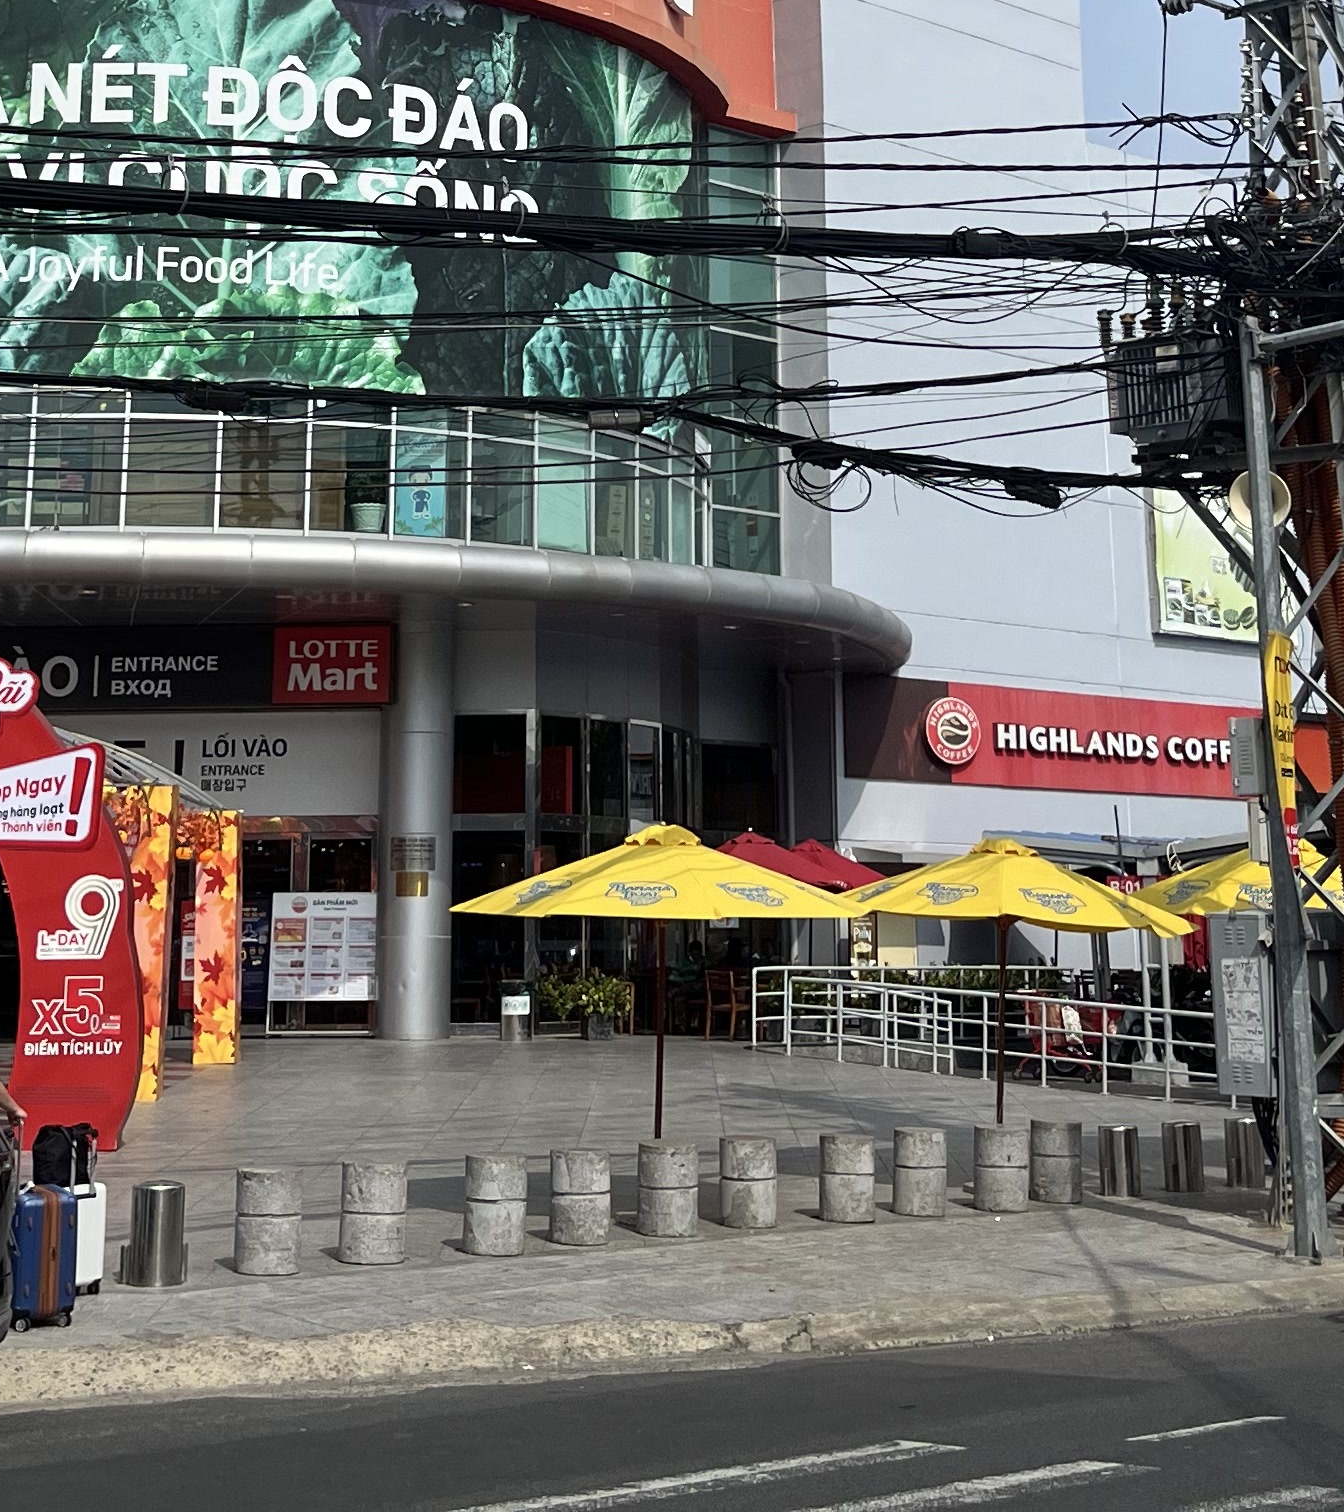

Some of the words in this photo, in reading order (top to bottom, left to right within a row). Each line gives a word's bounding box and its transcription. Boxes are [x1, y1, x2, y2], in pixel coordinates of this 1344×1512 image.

[28, 44, 189, 124] NÉT
[387, 78, 531, 164] ĐÁO
[18, 245, 145, 292] Joyful
[156, 245, 254, 285] Food
[264, 246, 340, 291] Life
[289, 639, 379, 659] LOTTE
[110, 654, 220, 673] ENTRANCE
[286, 661, 379, 692] Mart
[110, 678, 173, 699] ВХОД
[927, 700, 979, 730] HIGHLANDS
[201, 731, 237, 759] LỐI
[242, 732, 289, 758] VÀO
[935, 742, 976, 763] COFFEE
[995, 723, 1160, 760] HIGHLANDS
[1167, 736, 1232, 764] COFF
[201, 763, 266, 777] ENTRANCE
[15, 774, 67, 799] Ngay
[39, 802, 65, 819] loạt
[36, 819, 63, 832] viên
[40, 932, 90, 946] L-DAY
[23, 1039, 60, 1056] ĐIỂM
[60, 1038, 95, 1056] TÍCH
[96, 1038, 124, 1055] LŨY
